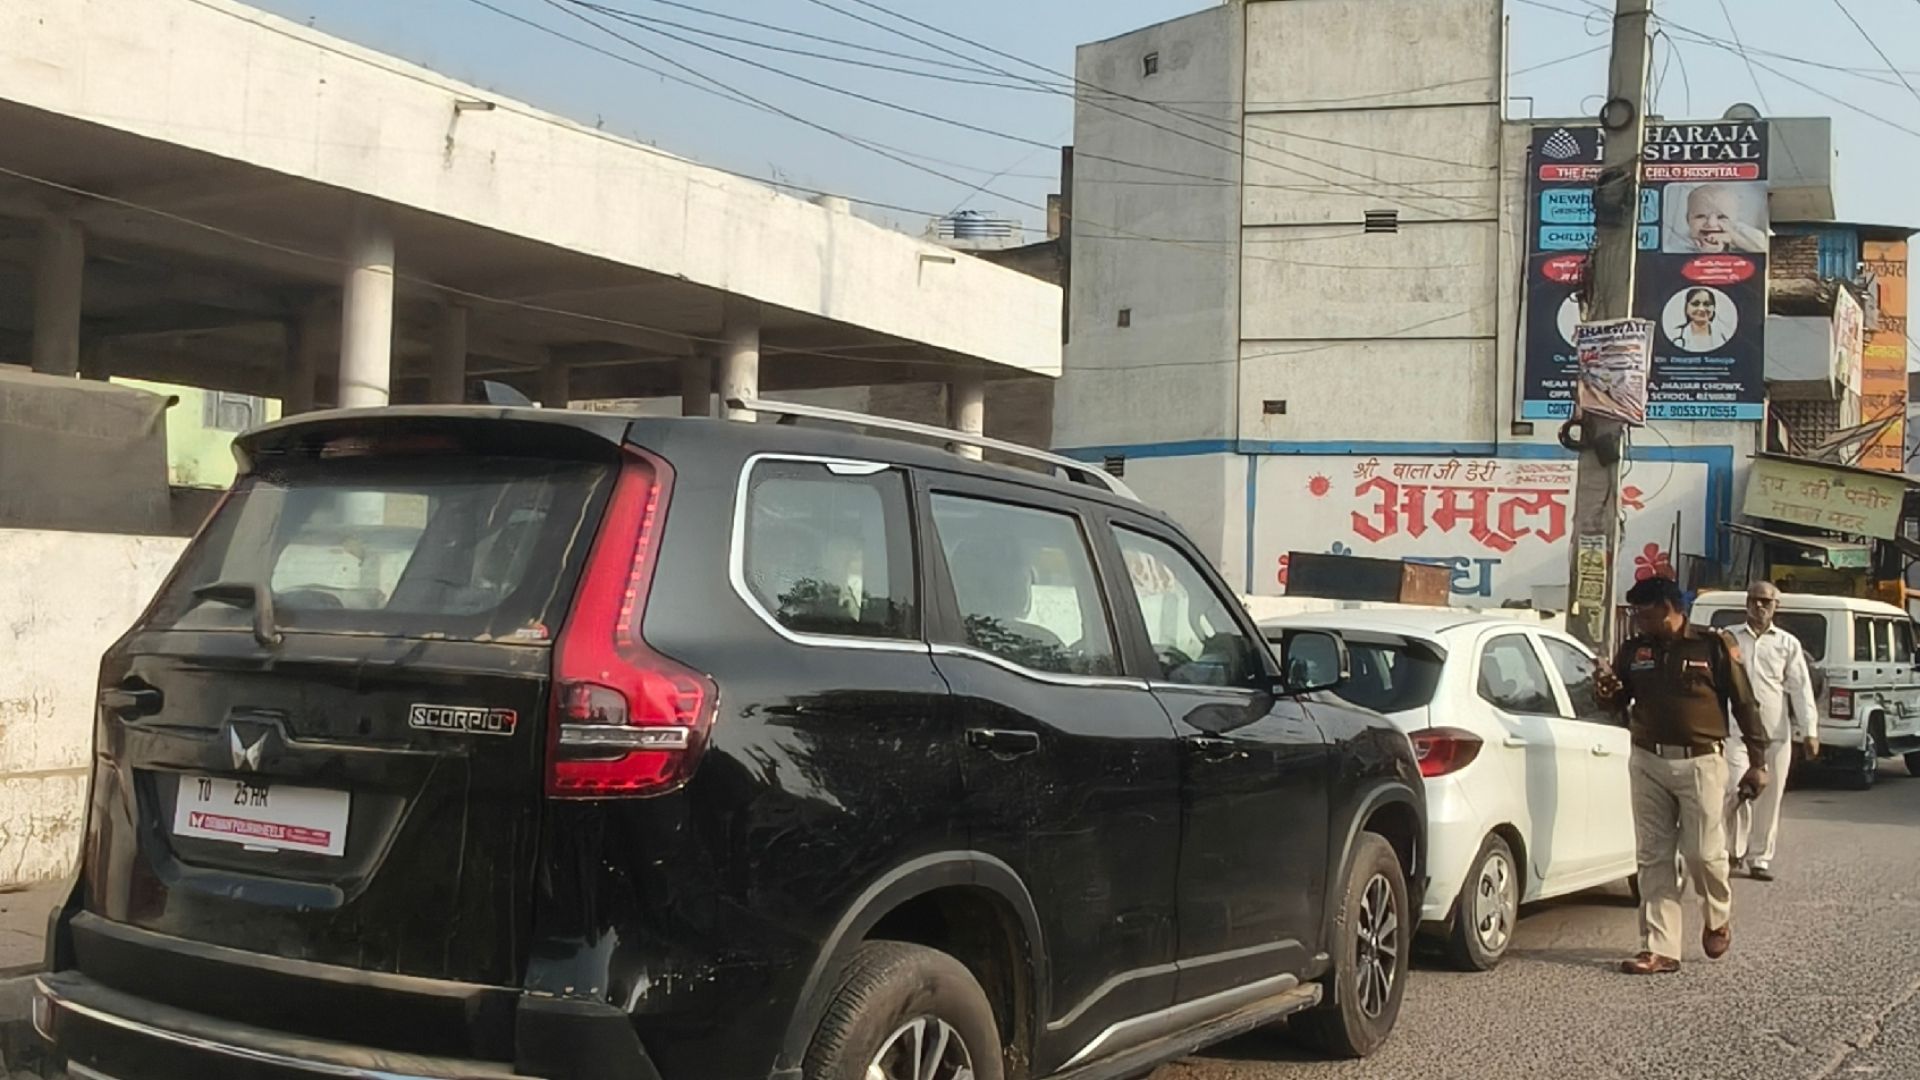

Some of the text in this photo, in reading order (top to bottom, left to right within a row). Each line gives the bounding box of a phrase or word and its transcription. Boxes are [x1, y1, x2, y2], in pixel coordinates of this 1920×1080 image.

[1596, 125, 1760, 143] HARAJA
[1594, 143, 1760, 161] SPITAL
[1465, 460, 1501, 482] डेरी
